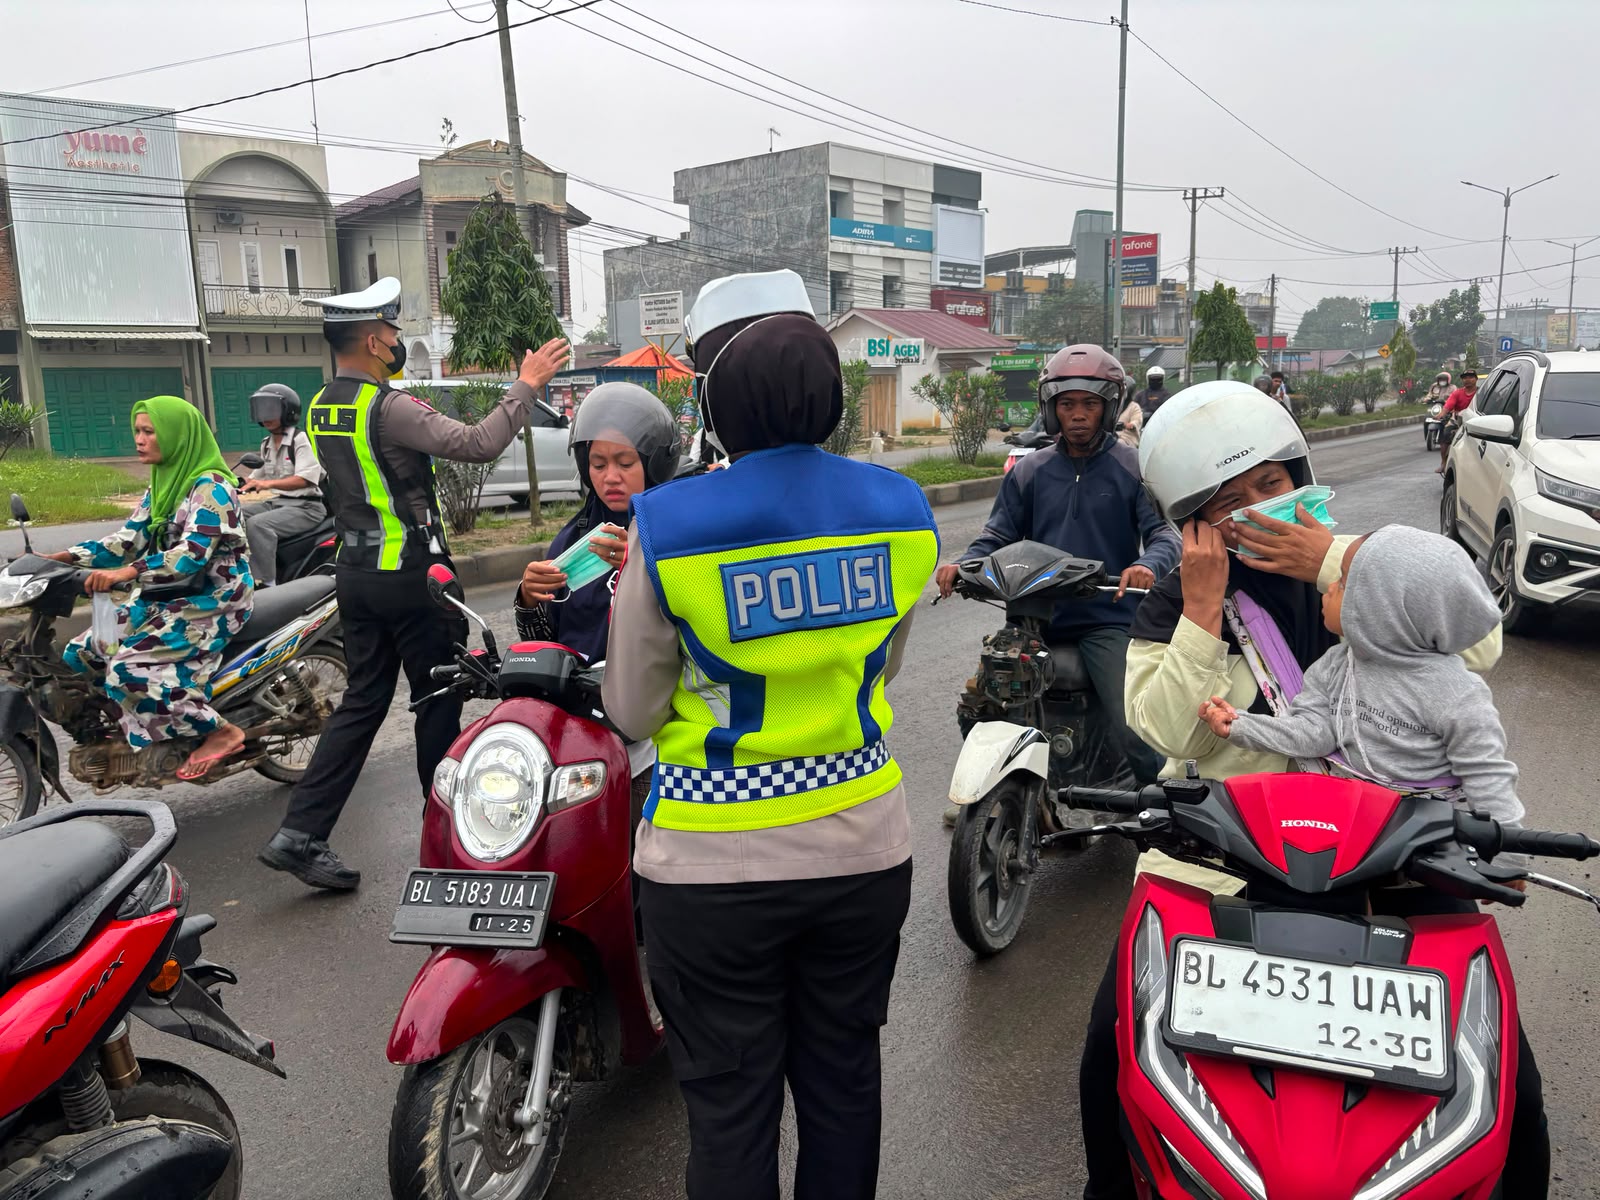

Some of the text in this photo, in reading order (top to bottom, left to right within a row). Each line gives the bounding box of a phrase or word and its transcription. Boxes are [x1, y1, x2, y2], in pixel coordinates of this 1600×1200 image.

[67, 156, 140, 173] Aesthetic
[852, 227, 875, 236] ADIRA
[1121, 240, 1153, 251] rafone
[867, 338, 920, 358] BSI AGEN
[311, 408, 358, 433] POLISI
[732, 553, 888, 627] POLISI
[1387, 714, 1428, 734] opinion
[1280, 819, 1340, 833] HONDA
[410, 880, 433, 903] BL
[445, 880, 494, 906] 5183
[1183, 950, 1432, 1021] BL 4531 UAW
